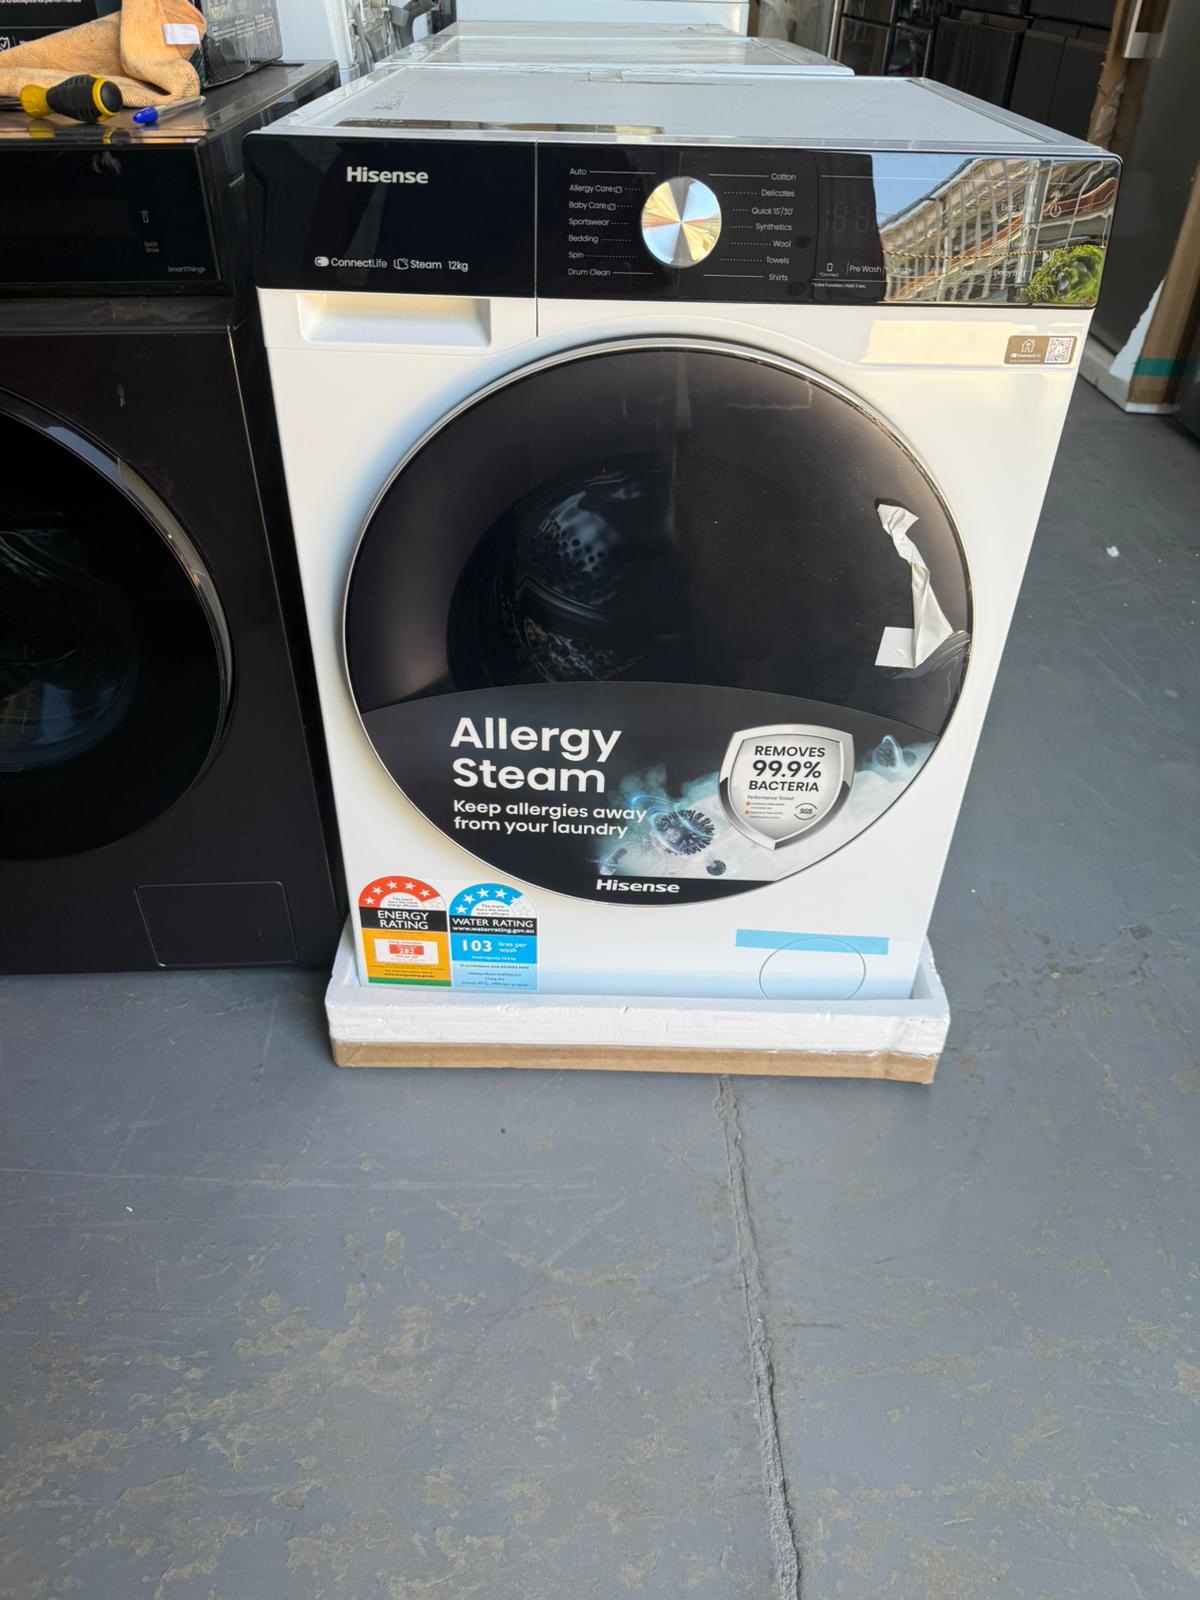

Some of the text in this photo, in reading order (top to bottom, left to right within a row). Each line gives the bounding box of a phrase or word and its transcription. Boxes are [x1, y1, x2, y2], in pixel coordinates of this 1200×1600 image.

[346, 166, 429, 184] Hisense
[569, 168, 587, 176] Auto
[771, 173, 797, 182] Cotton
[569, 184, 613, 194] Allergy Care
[761, 189, 795, 198] Delicates
[568, 201, 607, 210] Baby Care
[751, 207, 773, 216] Quick
[568, 218, 610, 227] Sportswear
[755, 223, 793, 232] Synthetics
[568, 234, 599, 244] Bedding
[772, 240, 792, 248] Wool
[568, 251, 585, 259] Spin
[330, 257, 469, 273] ConnectLife Steam 12kg
[766, 256, 790, 265] Towels
[167, 266, 206, 274] SmartThings
[568, 268, 611, 277] Drum Clean
[849, 265, 882, 273] Pre Wash
[768, 273, 789, 281] Shirts
[450, 717, 622, 763] Allergy
[754, 745, 826, 758] REMOVES
[752, 759, 822, 778] 99.9%
[452, 757, 606, 793] Steam
[749, 780, 819, 792] BACTERIA
[453, 800, 648, 824] Keep allergies away
[454, 816, 628, 839] from your laundry
[595, 879, 681, 894] Hisense
[377, 910, 429, 921] ENERGY
[379, 919, 429, 930] RATING
[452, 918, 534, 928] WATER RATING
[452, 926, 535, 934] www.waterrating.gov.au
[462, 939, 493, 952] 103
